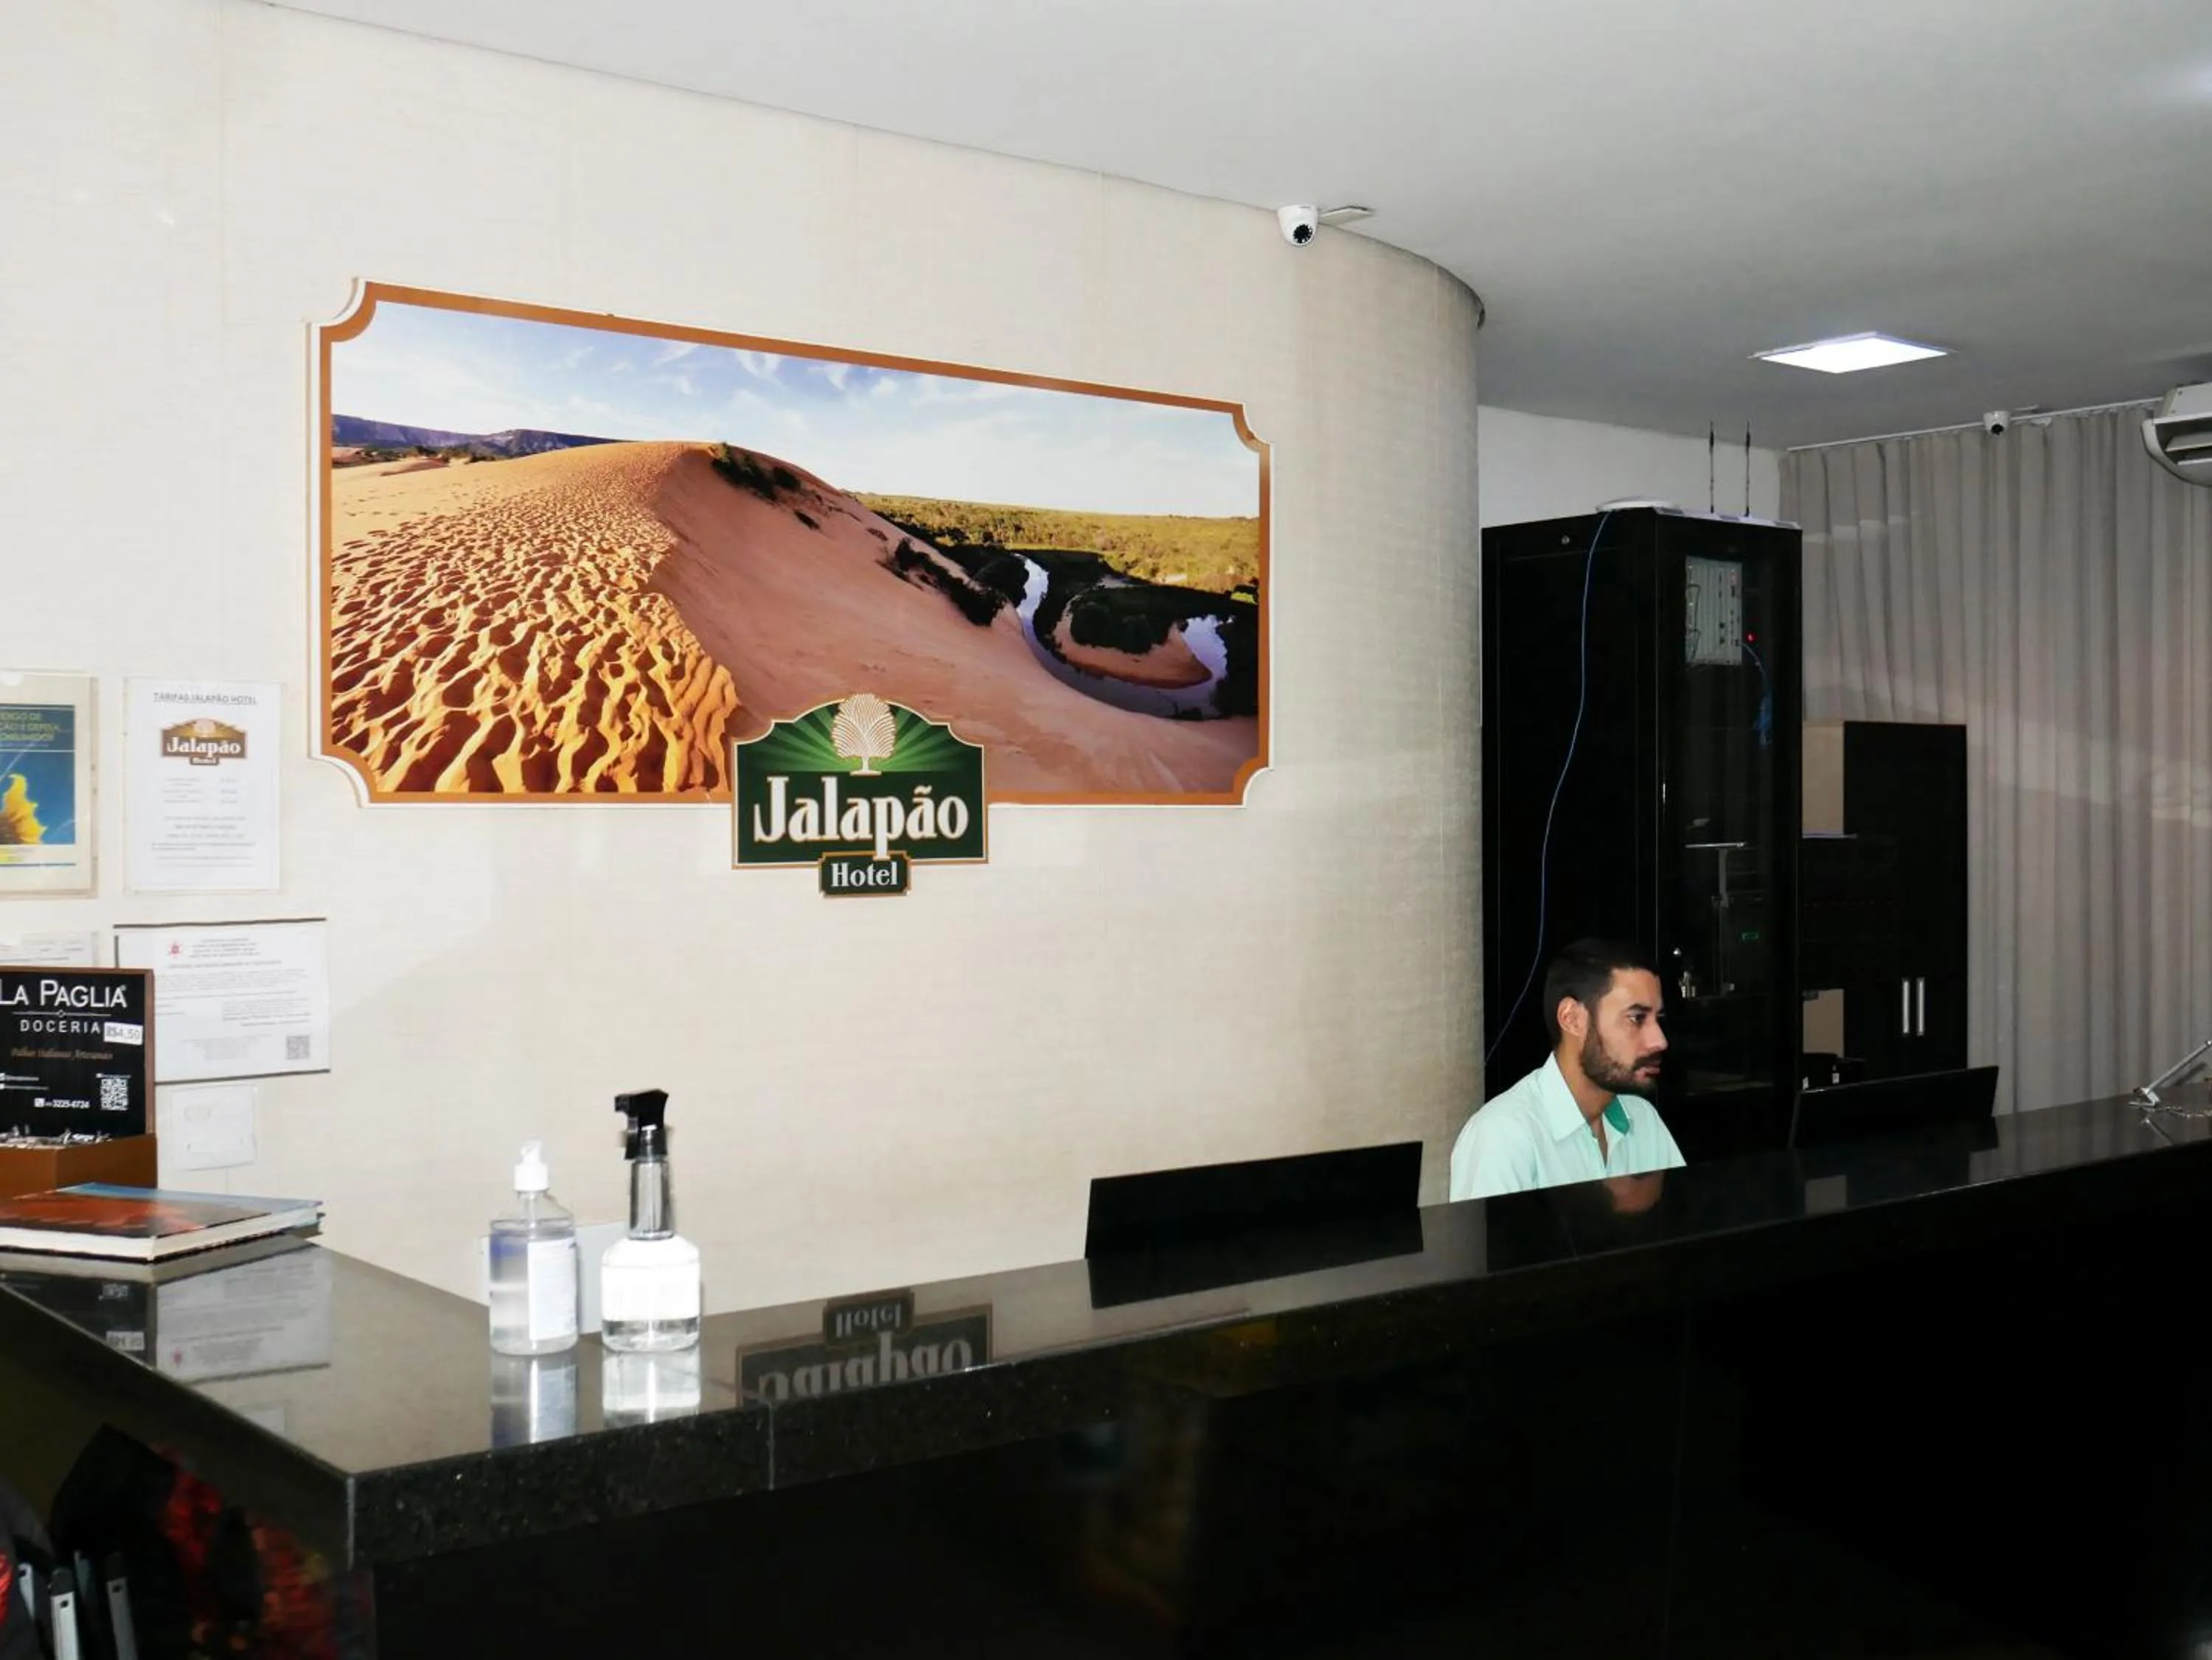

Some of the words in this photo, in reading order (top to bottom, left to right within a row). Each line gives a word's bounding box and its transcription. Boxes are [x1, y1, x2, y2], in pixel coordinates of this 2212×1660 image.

[167, 736, 242, 758] Jalapão
[754, 776, 970, 861] Jalapão
[831, 860, 898, 887] Hotel
[0, 979, 29, 1005] LA
[40, 979, 128, 1008] PAGLIA
[20, 1019, 100, 1034] DOCERIA
